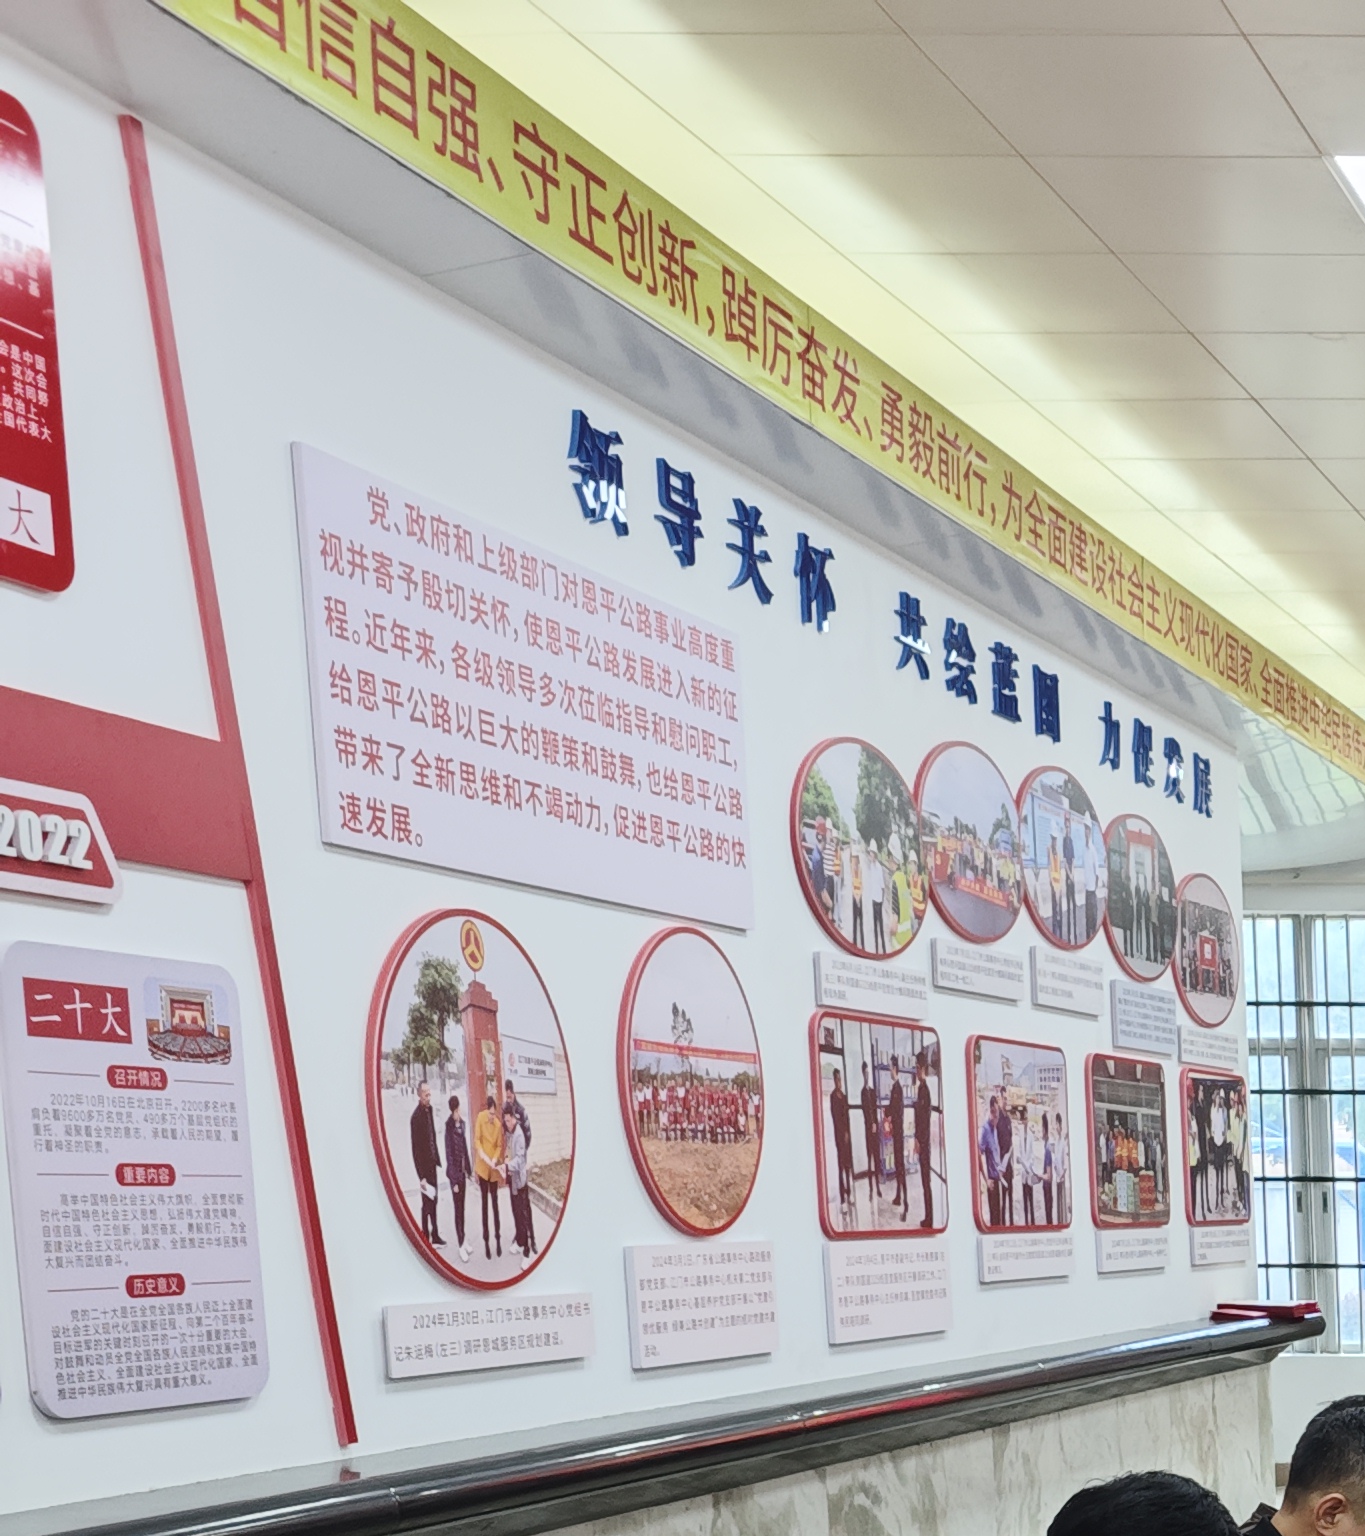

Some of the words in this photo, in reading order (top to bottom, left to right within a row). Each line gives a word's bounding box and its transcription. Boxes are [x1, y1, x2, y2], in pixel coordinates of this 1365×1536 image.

[0, 411, 53, 443] 国代表大
[567, 408, 835, 635] 领导关怀
[893, 591, 1062, 744] 共绘蓝图
[1097, 700, 1213, 819] 力促发展
[0, 804, 94, 871] 2022
[339, 790, 423, 848] 速发展。
[29, 987, 128, 1037] 二十大
[114, 1068, 162, 1088] 召开情况
[123, 1167, 170, 1184] 重要内容
[133, 1277, 180, 1296] 历史意义
